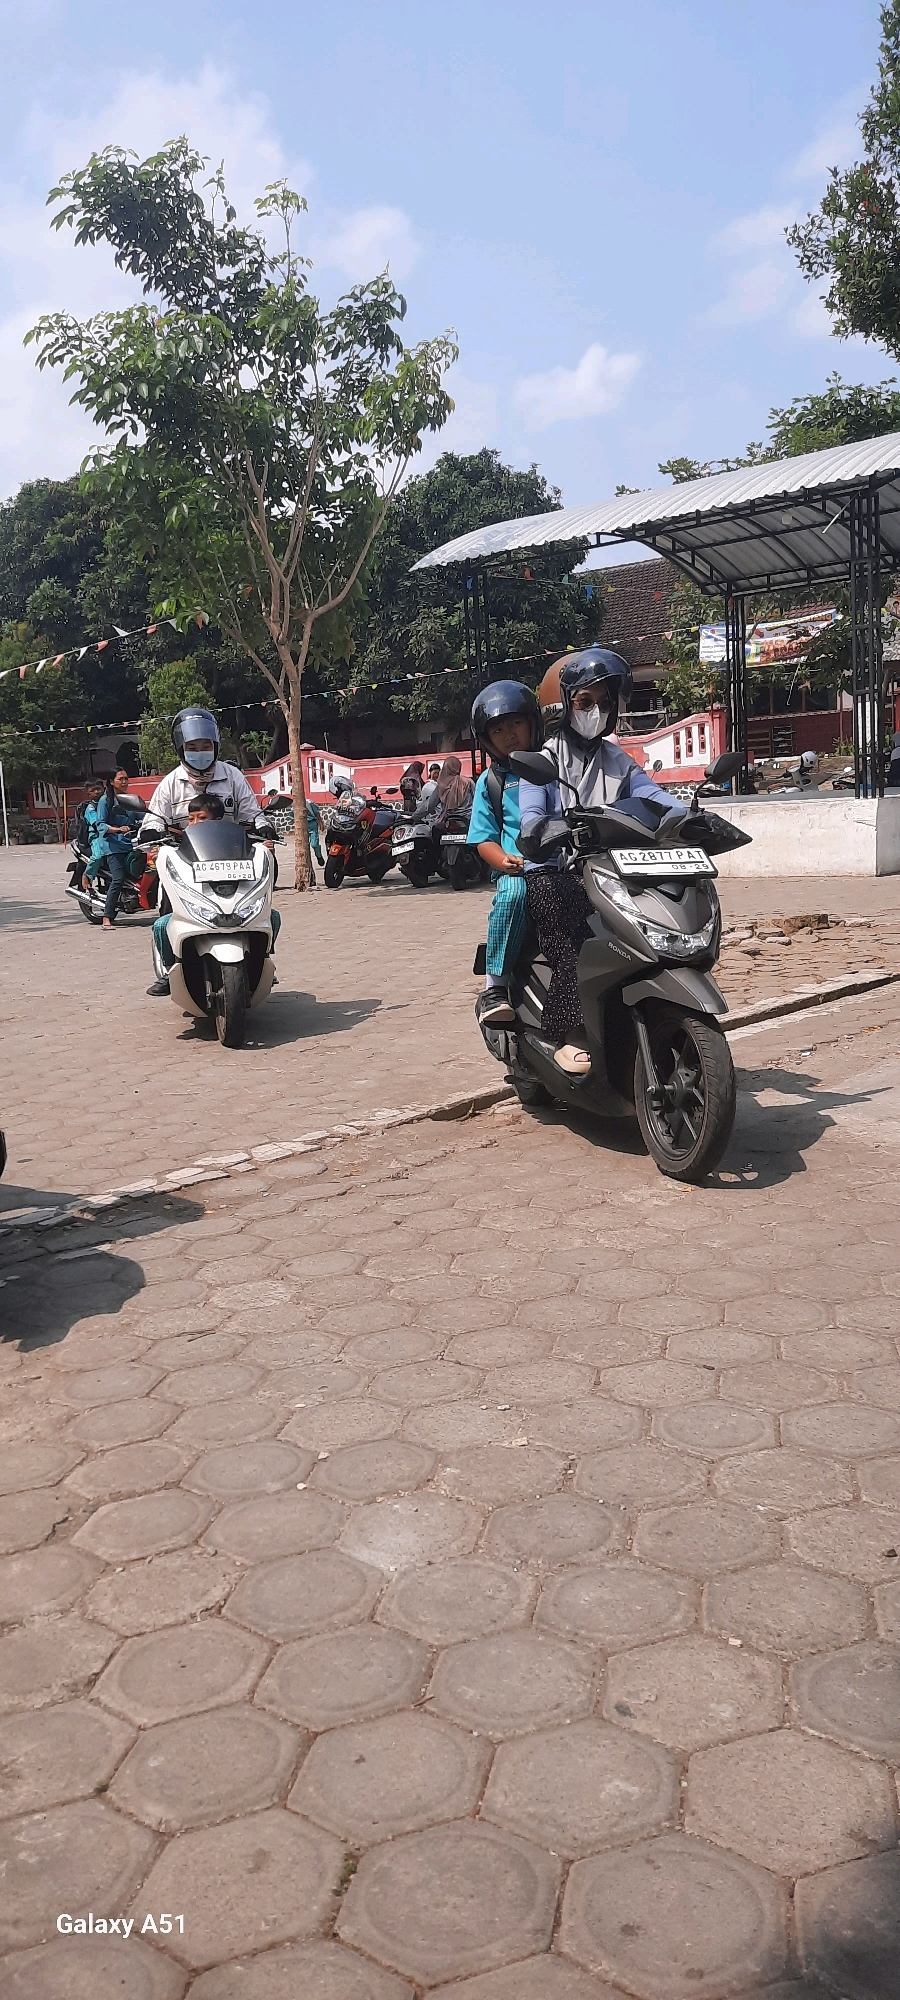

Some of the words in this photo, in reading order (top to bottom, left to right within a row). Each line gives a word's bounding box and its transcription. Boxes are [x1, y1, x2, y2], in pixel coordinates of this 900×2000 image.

[620, 852, 637, 862] AG
[639, 851, 673, 862] 2877
[676, 850, 704, 861] PAT
[607, 941, 632, 961] HONDA
